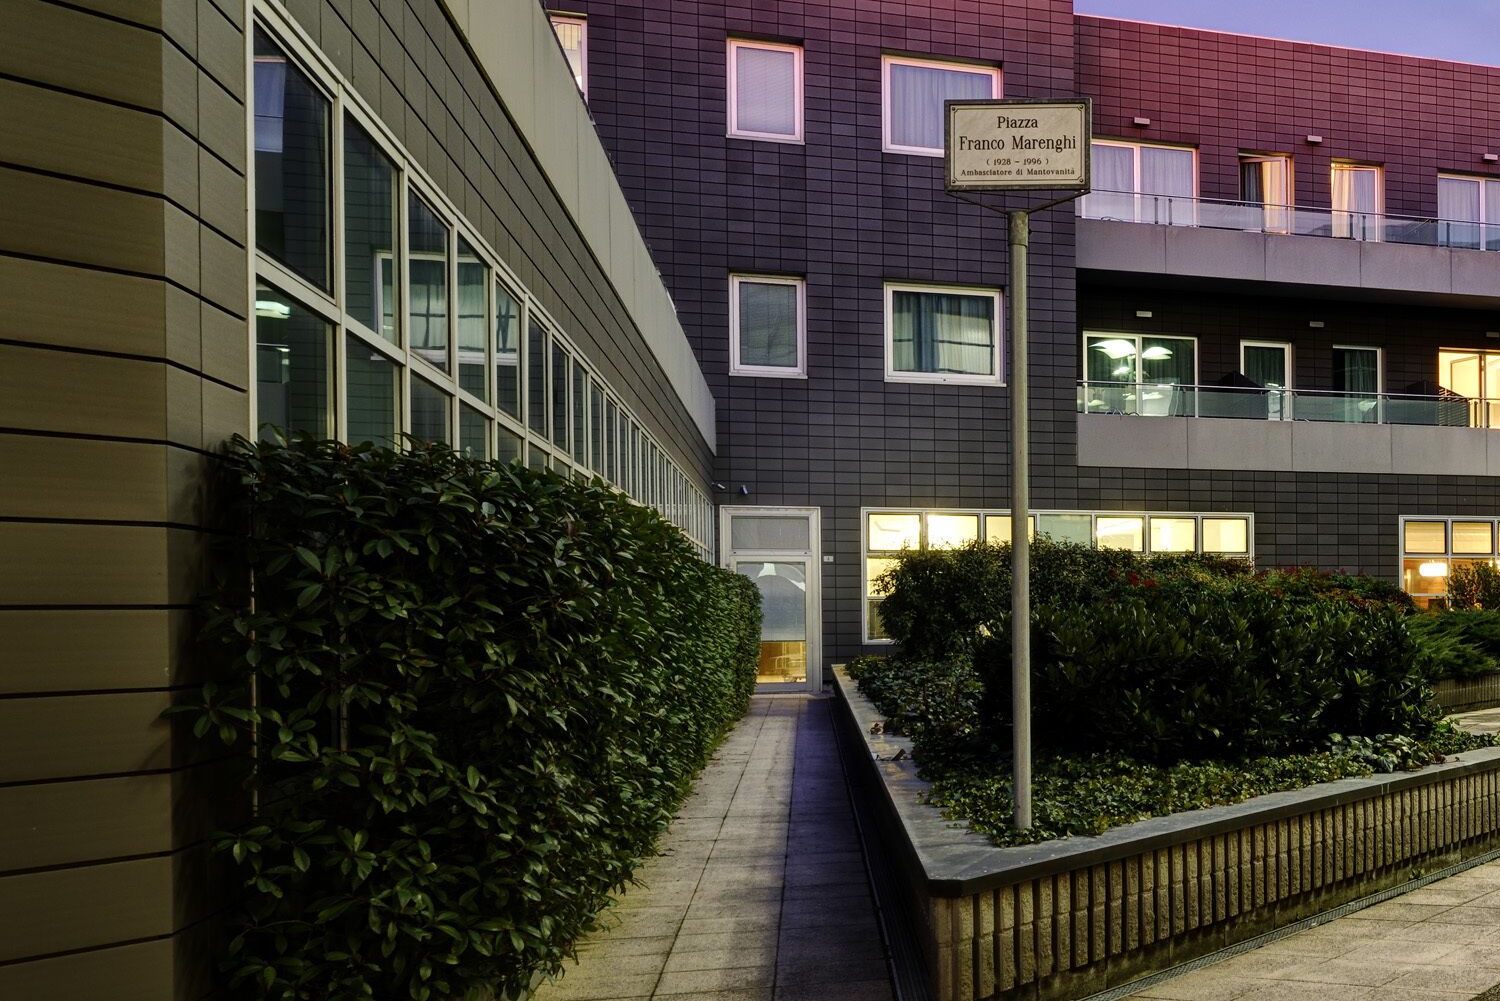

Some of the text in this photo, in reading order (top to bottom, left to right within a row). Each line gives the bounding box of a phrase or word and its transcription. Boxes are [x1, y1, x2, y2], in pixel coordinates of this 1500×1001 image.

[997, 116, 1038, 128] Piazza
[959, 135, 1076, 153] Franco Marenghi
[1015, 168, 1023, 176] di
[1026, 167, 1075, 176] Mantovanità
